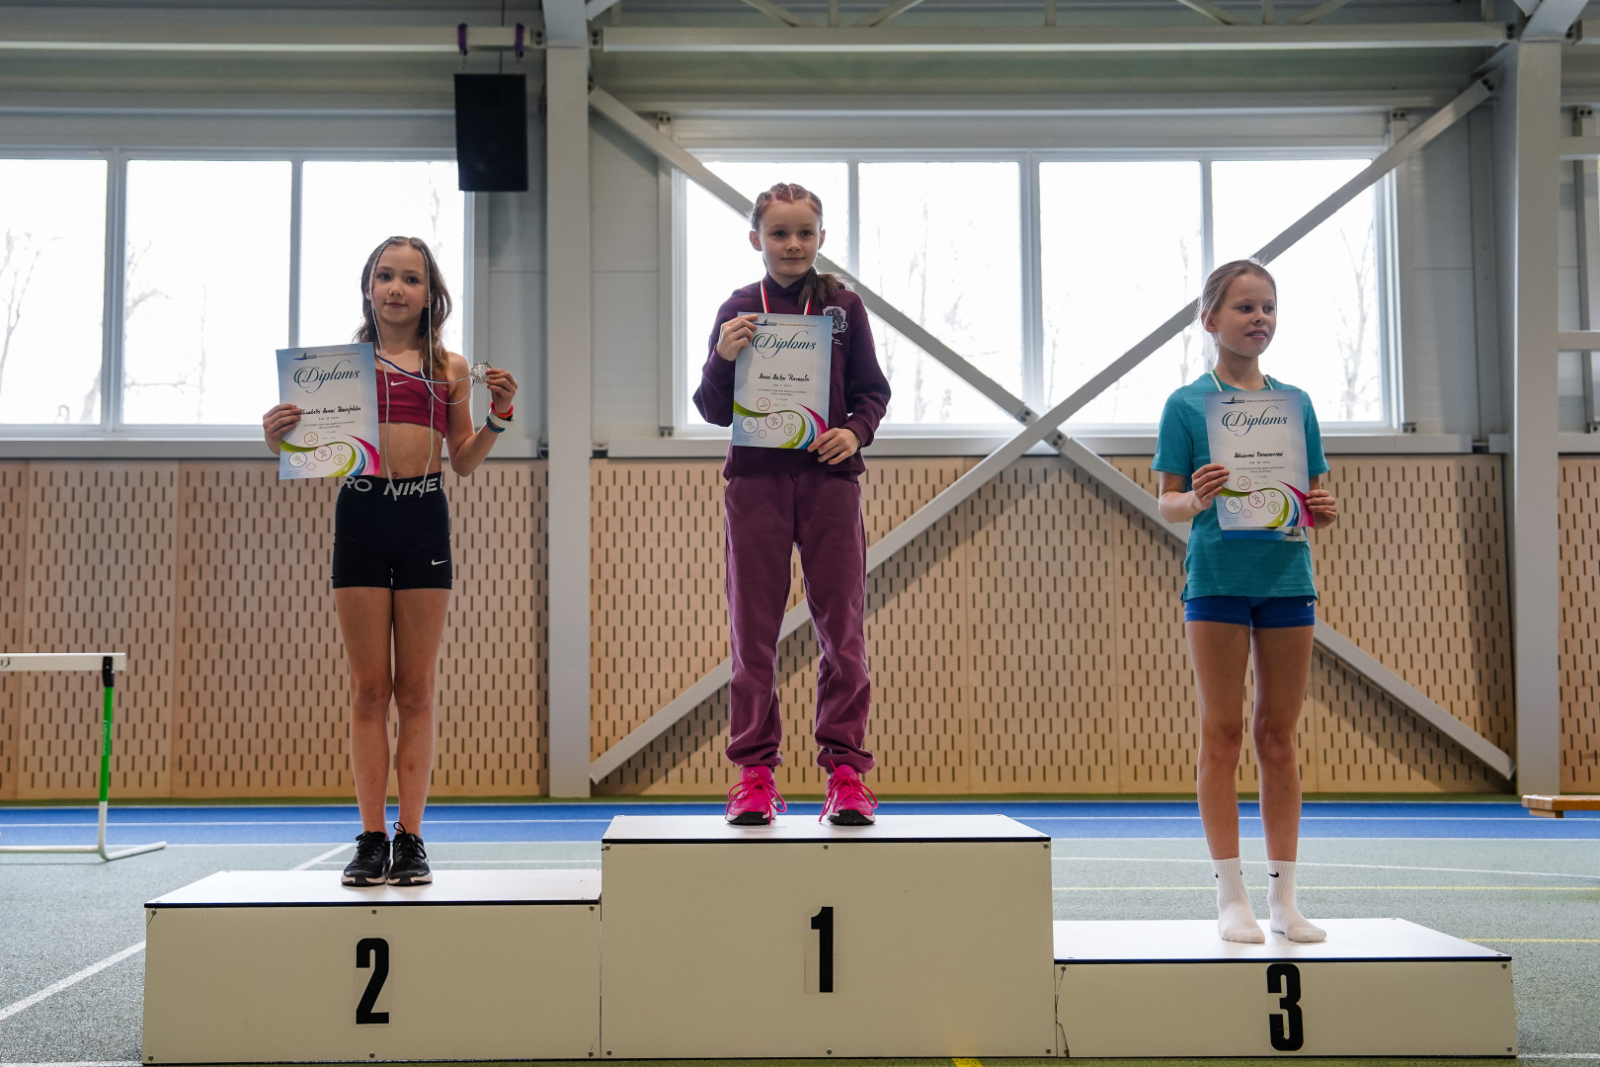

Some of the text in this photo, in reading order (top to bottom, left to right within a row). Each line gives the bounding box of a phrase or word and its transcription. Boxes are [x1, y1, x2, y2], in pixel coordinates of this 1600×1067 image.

[751, 330, 817, 359] Diploms
[293, 359, 360, 393] Diploms
[1221, 405, 1288, 437] Diploms
[383, 477, 438, 496] NIKE
[811, 906, 834, 993] 1
[356, 938, 389, 1024] 2
[1266, 963, 1304, 1051] 3
